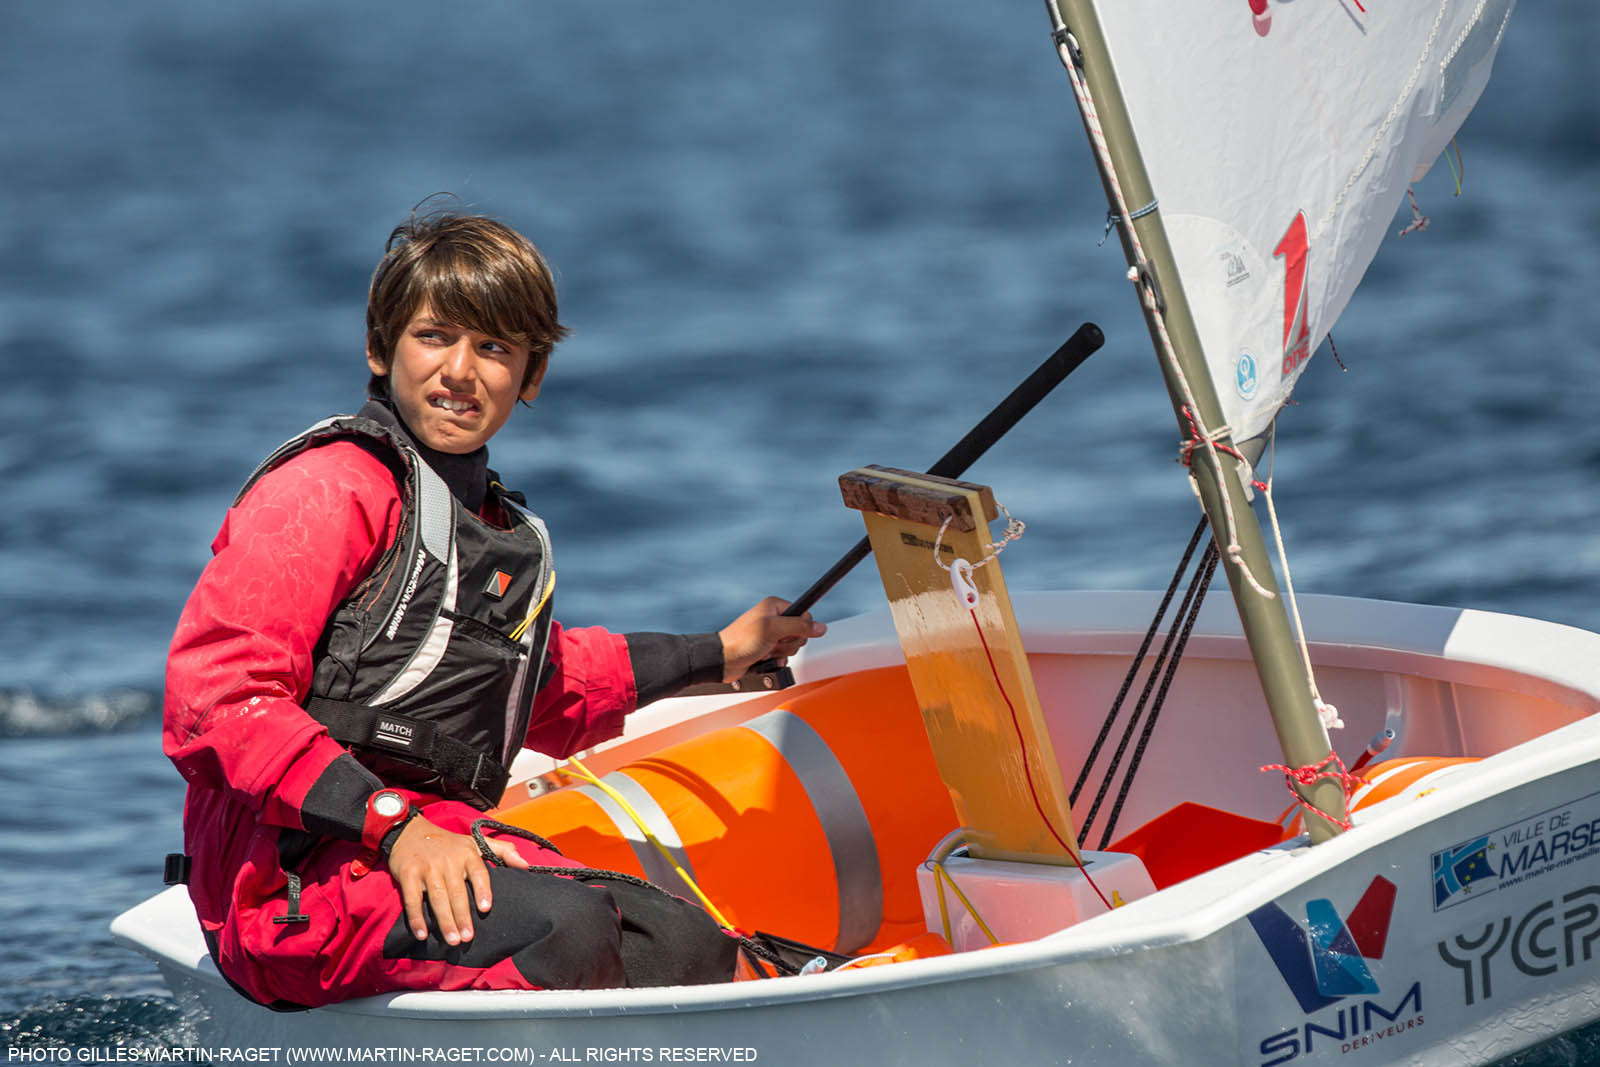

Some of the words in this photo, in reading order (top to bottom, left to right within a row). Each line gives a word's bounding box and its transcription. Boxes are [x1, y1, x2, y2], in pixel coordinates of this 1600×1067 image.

[1272, 208, 1311, 352] 1
[1282, 341, 1309, 374] one
[380, 721, 413, 737] MATCH
[1503, 820, 1545, 847] VILLE
[1549, 810, 1571, 831] DE
[1500, 818, 1600, 879] MARSE
[1260, 981, 1422, 1067] SNIM
[1341, 1015, 1425, 1054] DERIVEURS
